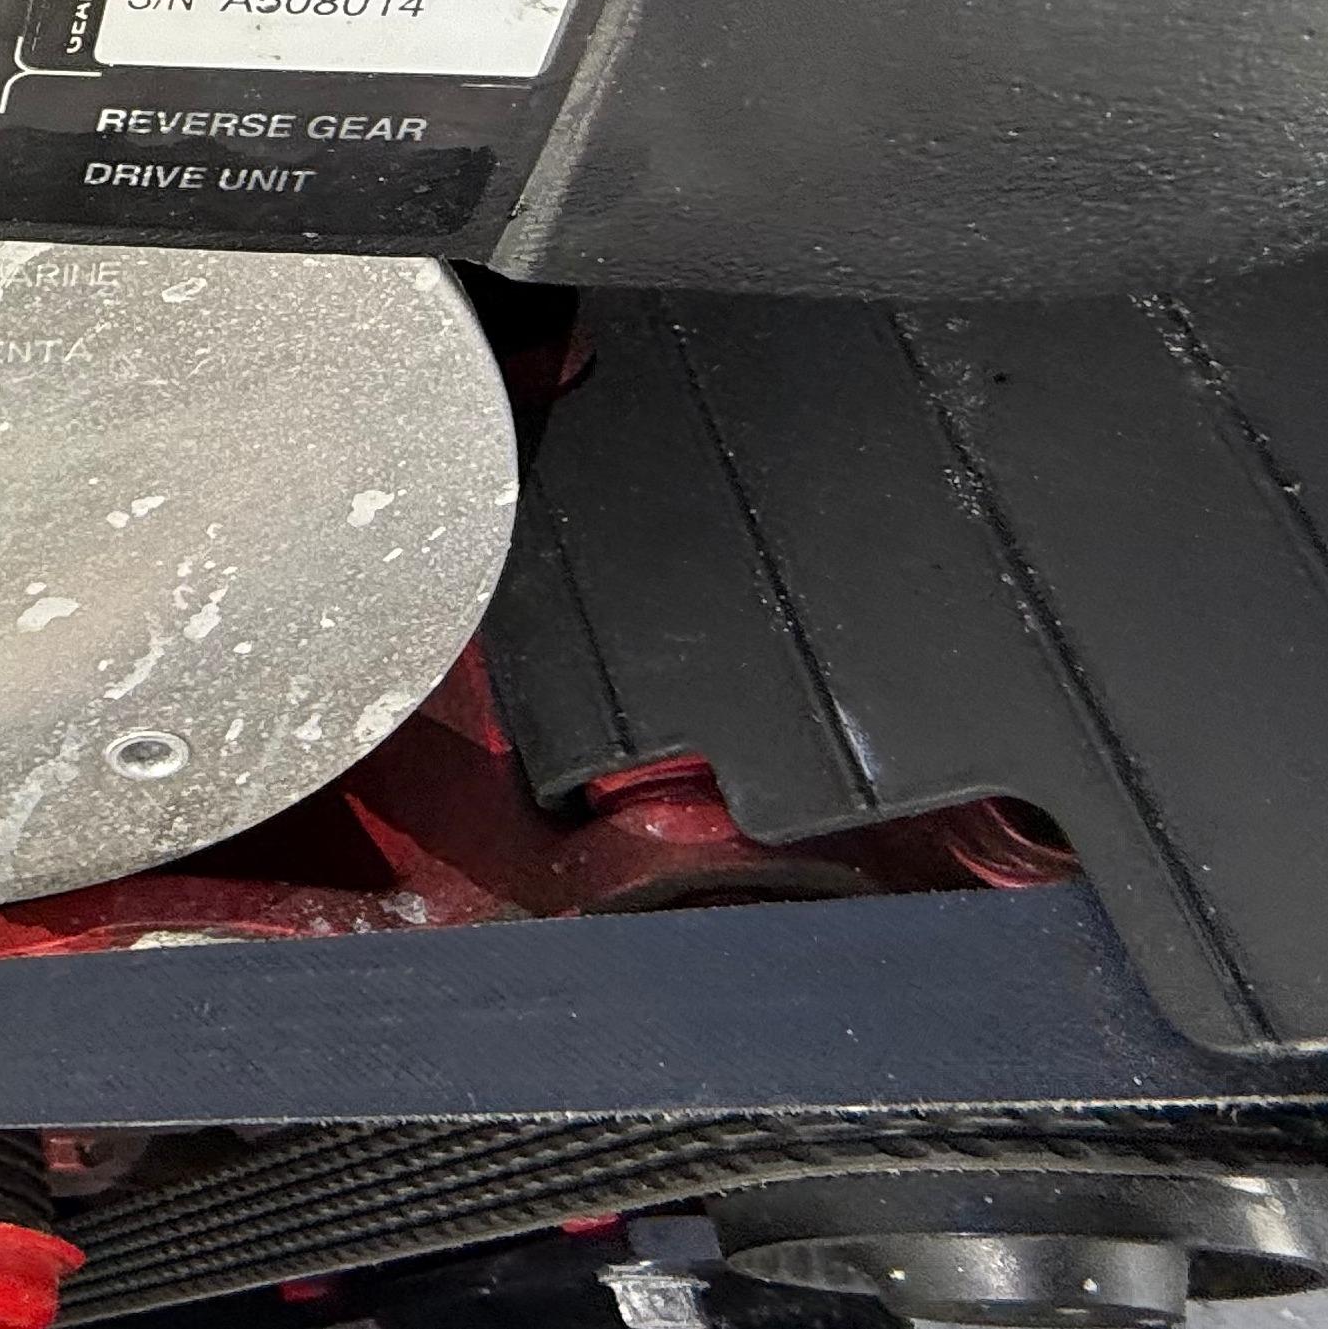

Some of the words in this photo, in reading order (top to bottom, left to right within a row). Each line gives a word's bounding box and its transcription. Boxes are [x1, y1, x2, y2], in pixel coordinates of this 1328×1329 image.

[95, 108, 297, 140] REVERSE
[307, 115, 428, 143] GEAR
[83, 162, 207, 190] DRIVE
[219, 167, 316, 194] UNIT
